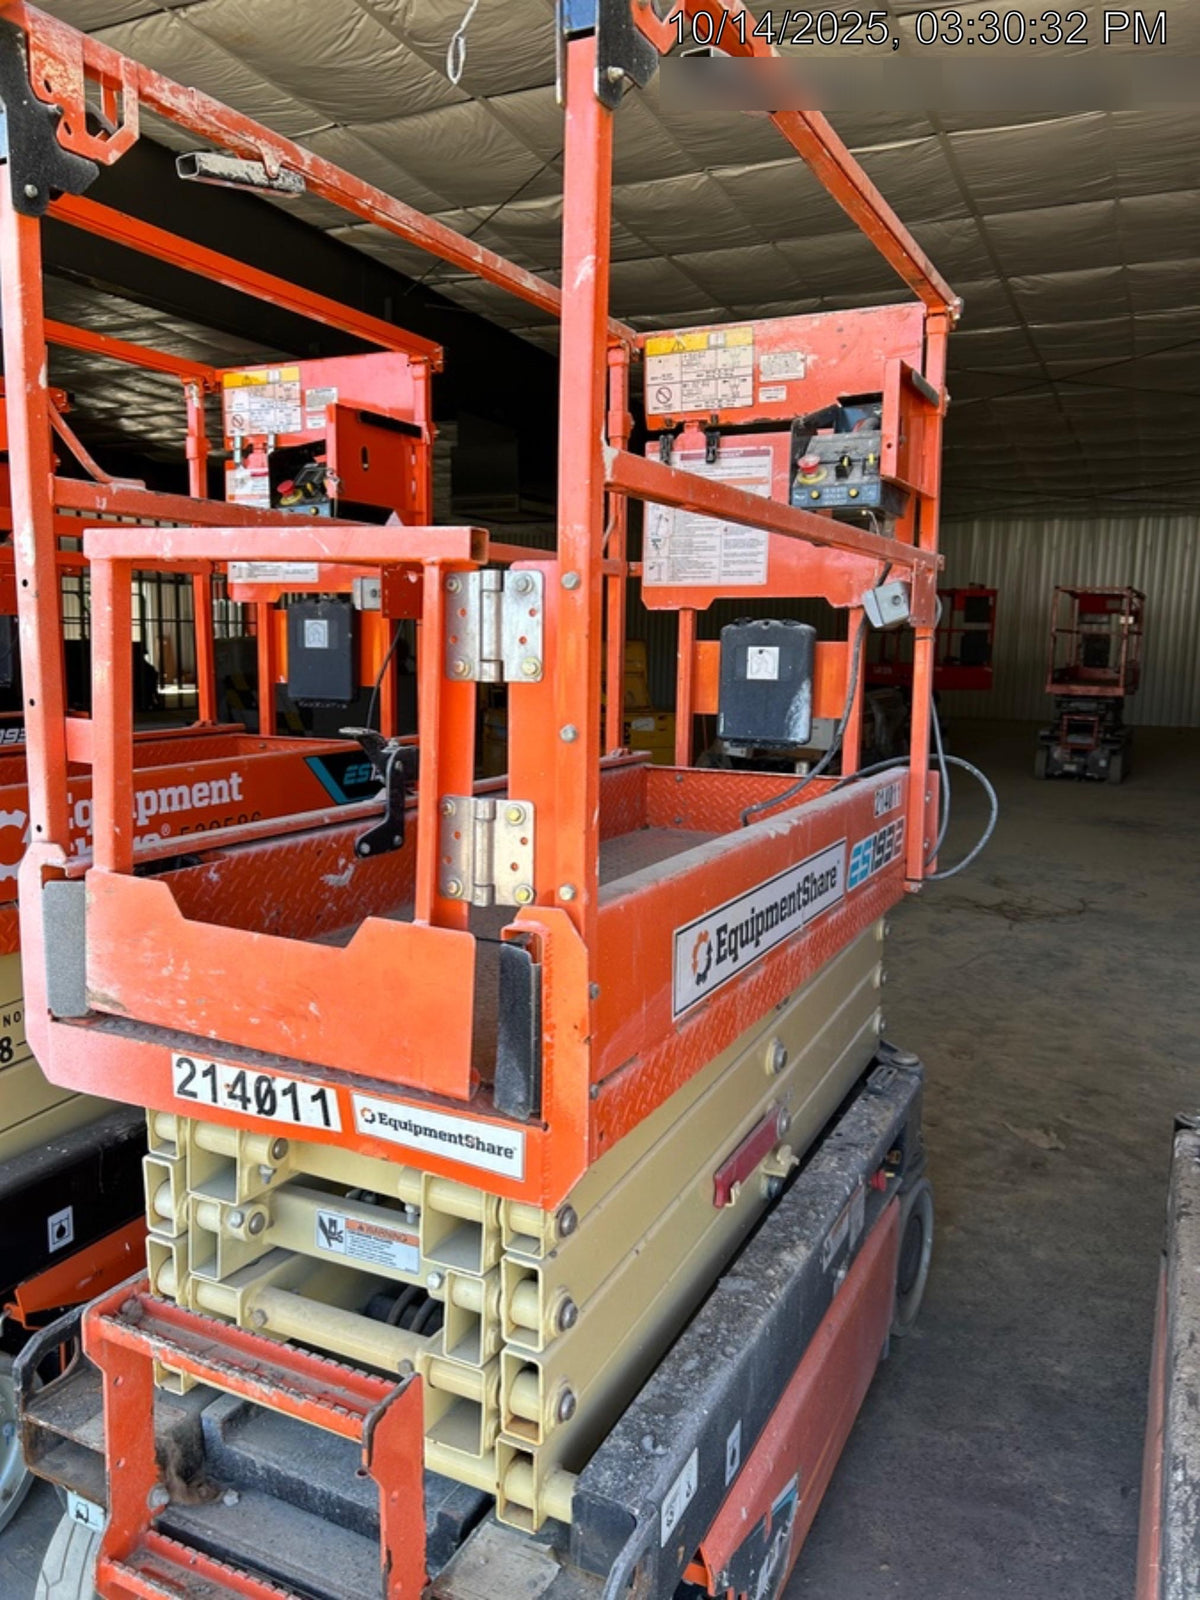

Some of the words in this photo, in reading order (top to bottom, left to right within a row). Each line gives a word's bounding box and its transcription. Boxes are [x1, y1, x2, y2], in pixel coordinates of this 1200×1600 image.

[715, 865, 837, 966] EquipmentShare
[175, 1056, 331, 1127] 214011
[377, 1111, 515, 1160] EquipmentShare
